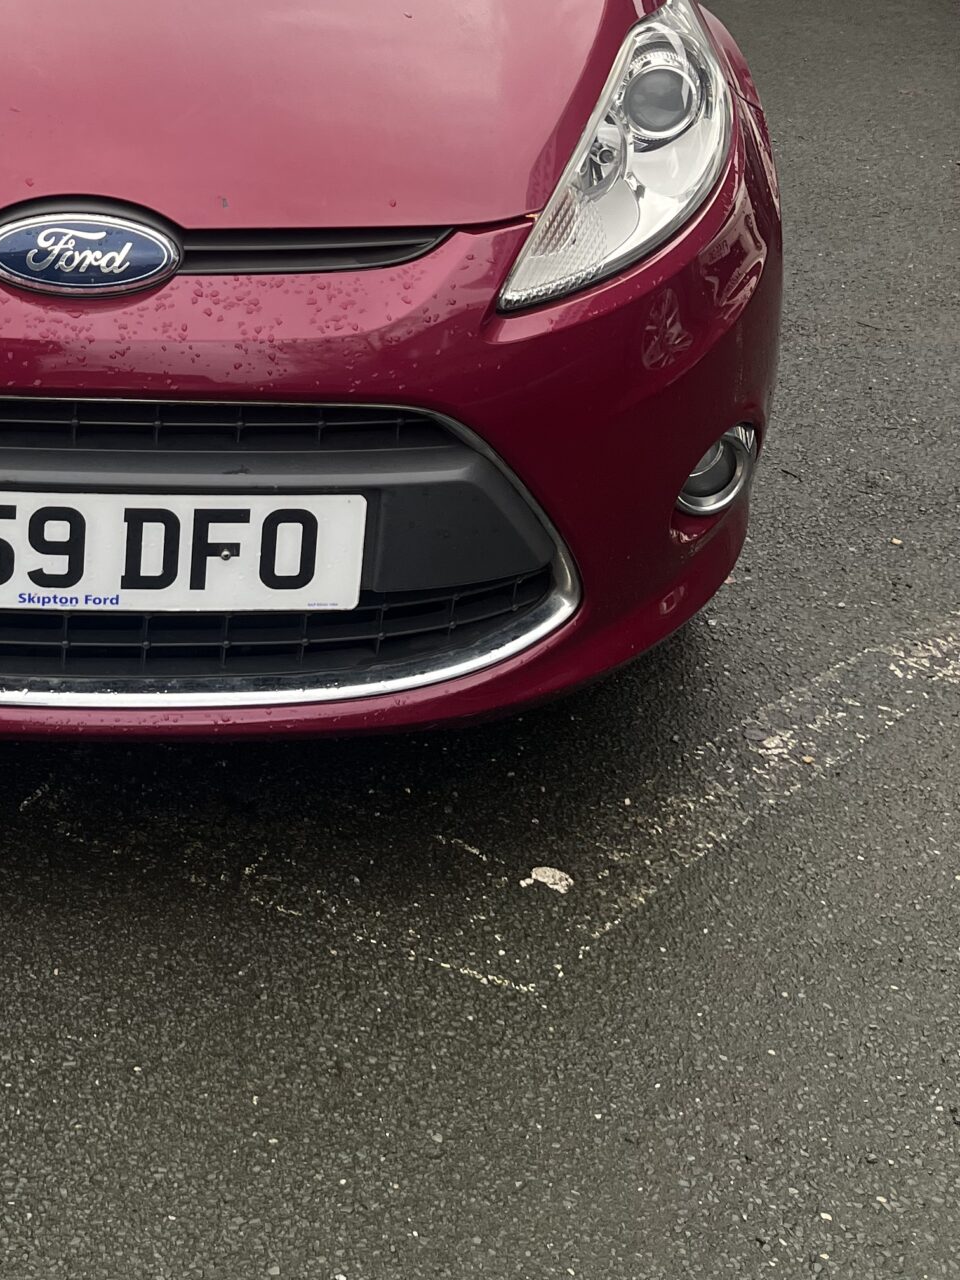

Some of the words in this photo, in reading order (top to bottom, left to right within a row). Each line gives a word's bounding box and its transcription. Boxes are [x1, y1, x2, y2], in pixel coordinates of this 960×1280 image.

[25, 227, 132, 274] Ford
[121, 507, 319, 592] DFO
[18, 593, 79, 606] Skipton
[85, 595, 120, 605] Ford
